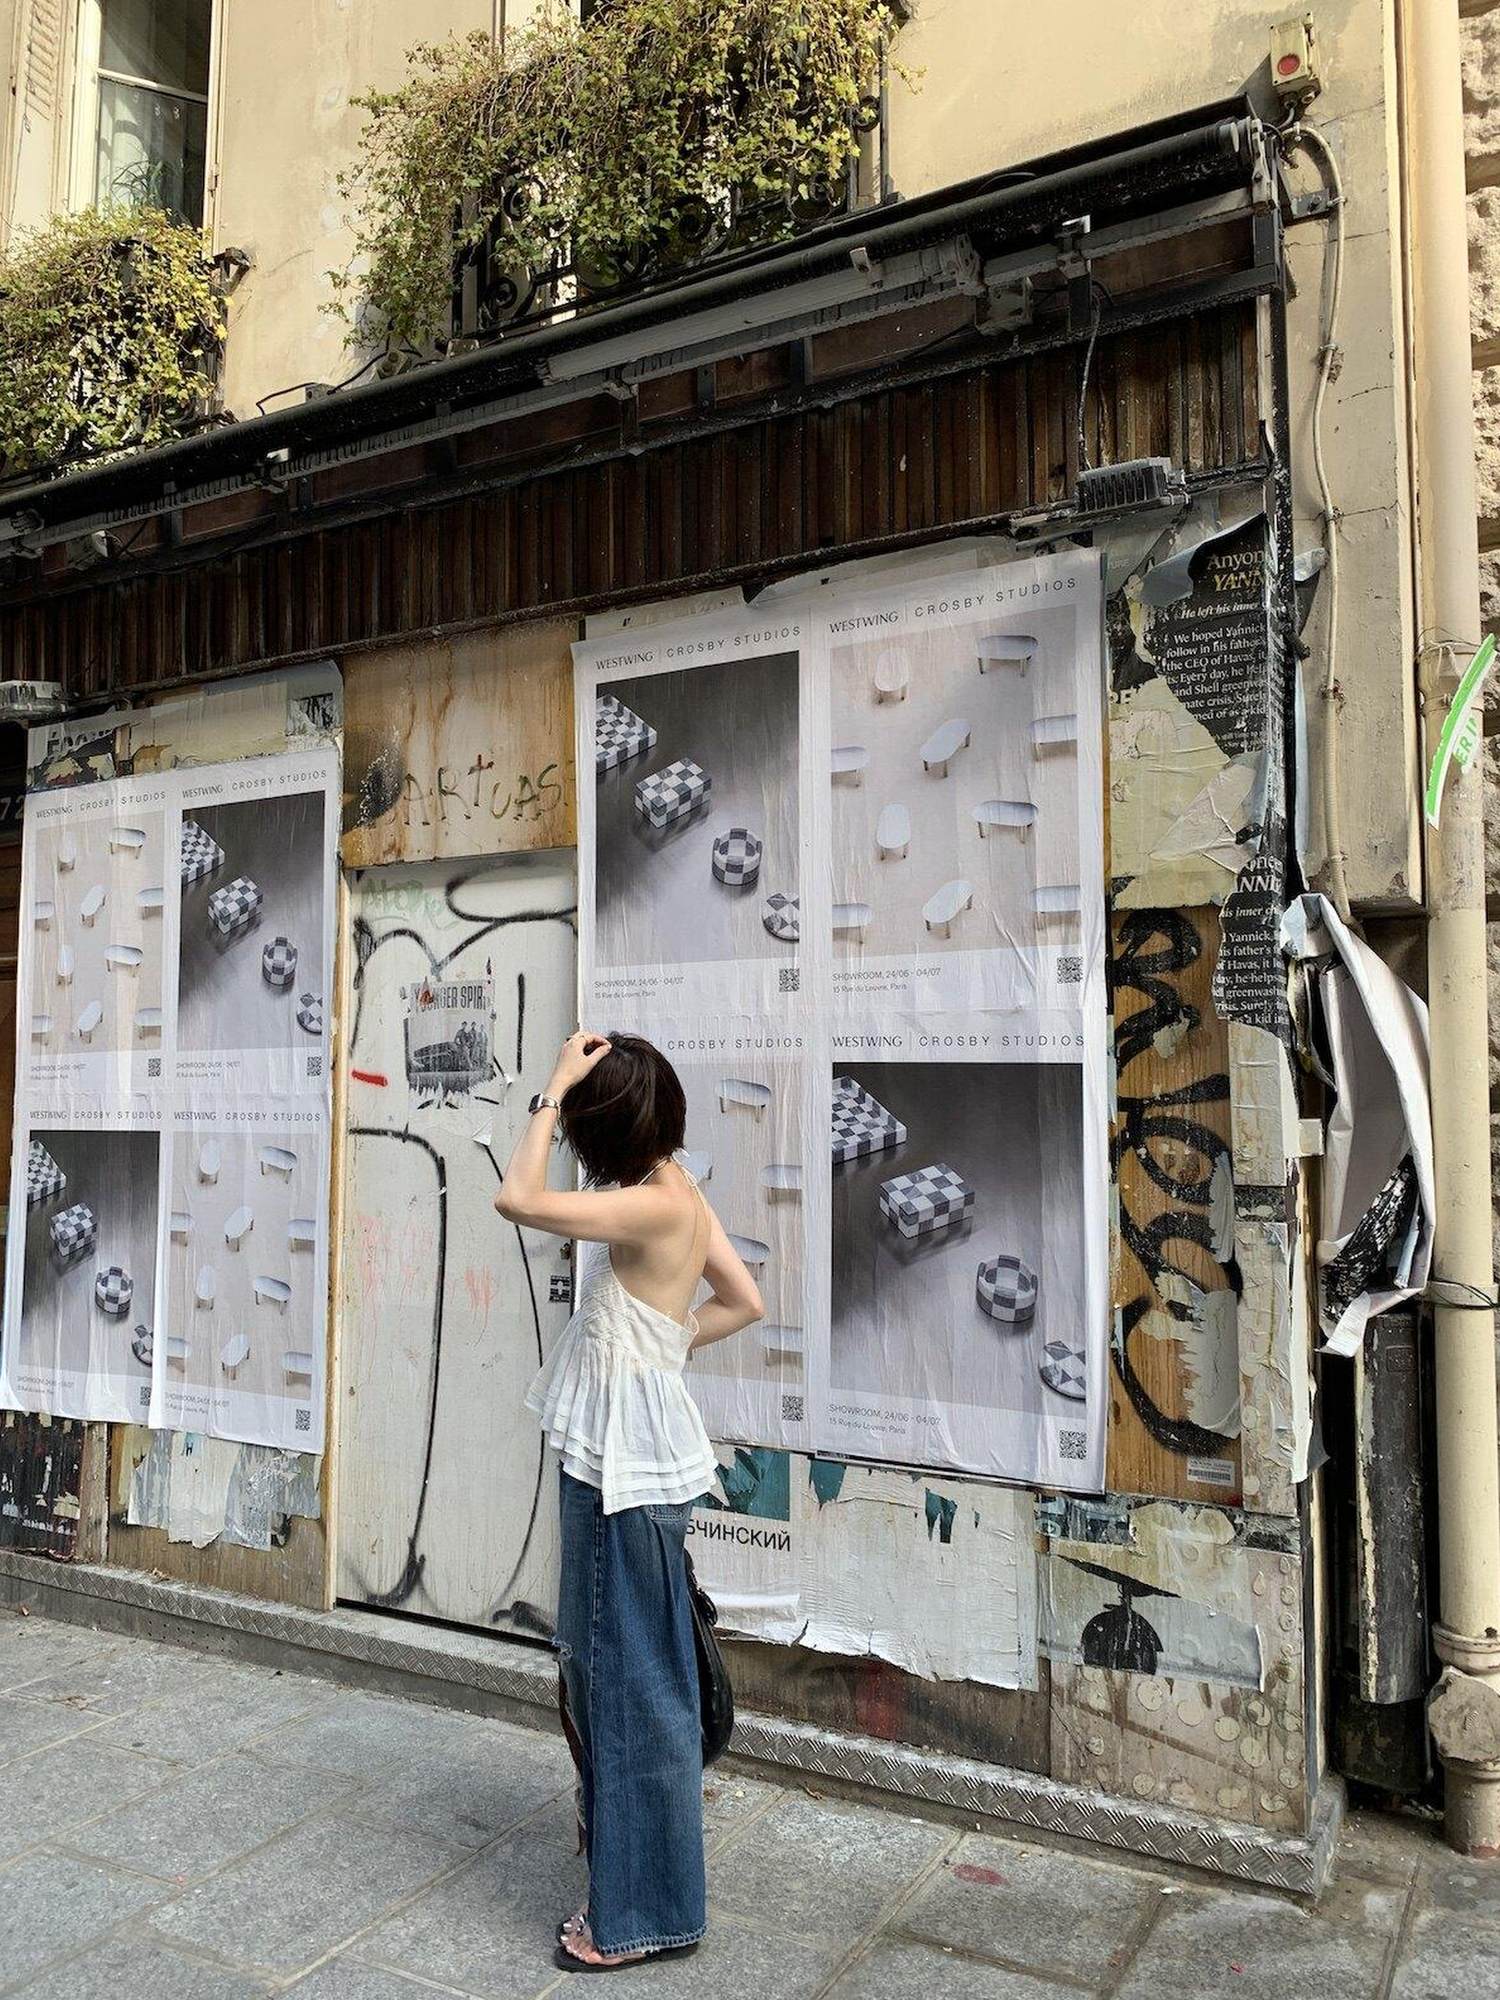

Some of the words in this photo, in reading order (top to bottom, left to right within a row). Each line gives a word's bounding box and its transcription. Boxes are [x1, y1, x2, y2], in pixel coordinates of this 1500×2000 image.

[829, 611, 899, 634] WESTWING
[914, 595, 985, 618] CROSBY
[996, 577, 1078, 602] STUDIOS
[1198, 604, 1214, 618] left
[1216, 601, 1232, 614] his
[1174, 633, 1190, 645] We
[1192, 627, 1223, 642] hoped
[596, 650, 655, 671] WESTWING
[666, 638, 726, 659] CROSBY
[734, 625, 801, 647] STUDIOS
[1166, 646, 1198, 659] follow
[1200, 643, 1210, 654] in
[1213, 640, 1228, 652] his
[1167, 660, 1183, 672] the
[1185, 657, 1209, 670] CEO
[1210, 654, 1222, 666] of
[1180, 672, 1207, 686] Every
[1231, 666, 1244, 677] he
[1195, 682, 1220, 695] Shell
[1216, 707, 1227, 719] of
[182, 784, 224, 799] WESTWING
[232, 777, 274, 791] CROSBY
[280, 769, 327, 785] STUDIOS
[121, 791, 166, 805] STUDIOS
[1236, 906, 1264, 917] inner
[1233, 944, 1272, 956] father's
[885, 969, 910, 979] 24/06
[916, 967, 941, 978] 04/07
[1235, 973, 1248, 983] he
[667, 1039, 726, 1051] CROSBY
[735, 1037, 803, 1049] STUDIOS
[832, 1036, 902, 1048] WESTWING
[919, 1035, 991, 1047] CROSBY
[1002, 1034, 1085, 1047] STUDIOS
[30, 1110, 67, 1120] WESTWING
[74, 1110, 110, 1120] CROSBY
[117, 1110, 162, 1120] STUDIOS
[174, 1111, 217, 1121] WESTWING
[225, 1112, 268, 1121] CROSBY
[272, 1112, 321, 1122] STUDIOS
[884, 1410, 910, 1423] 24/06
